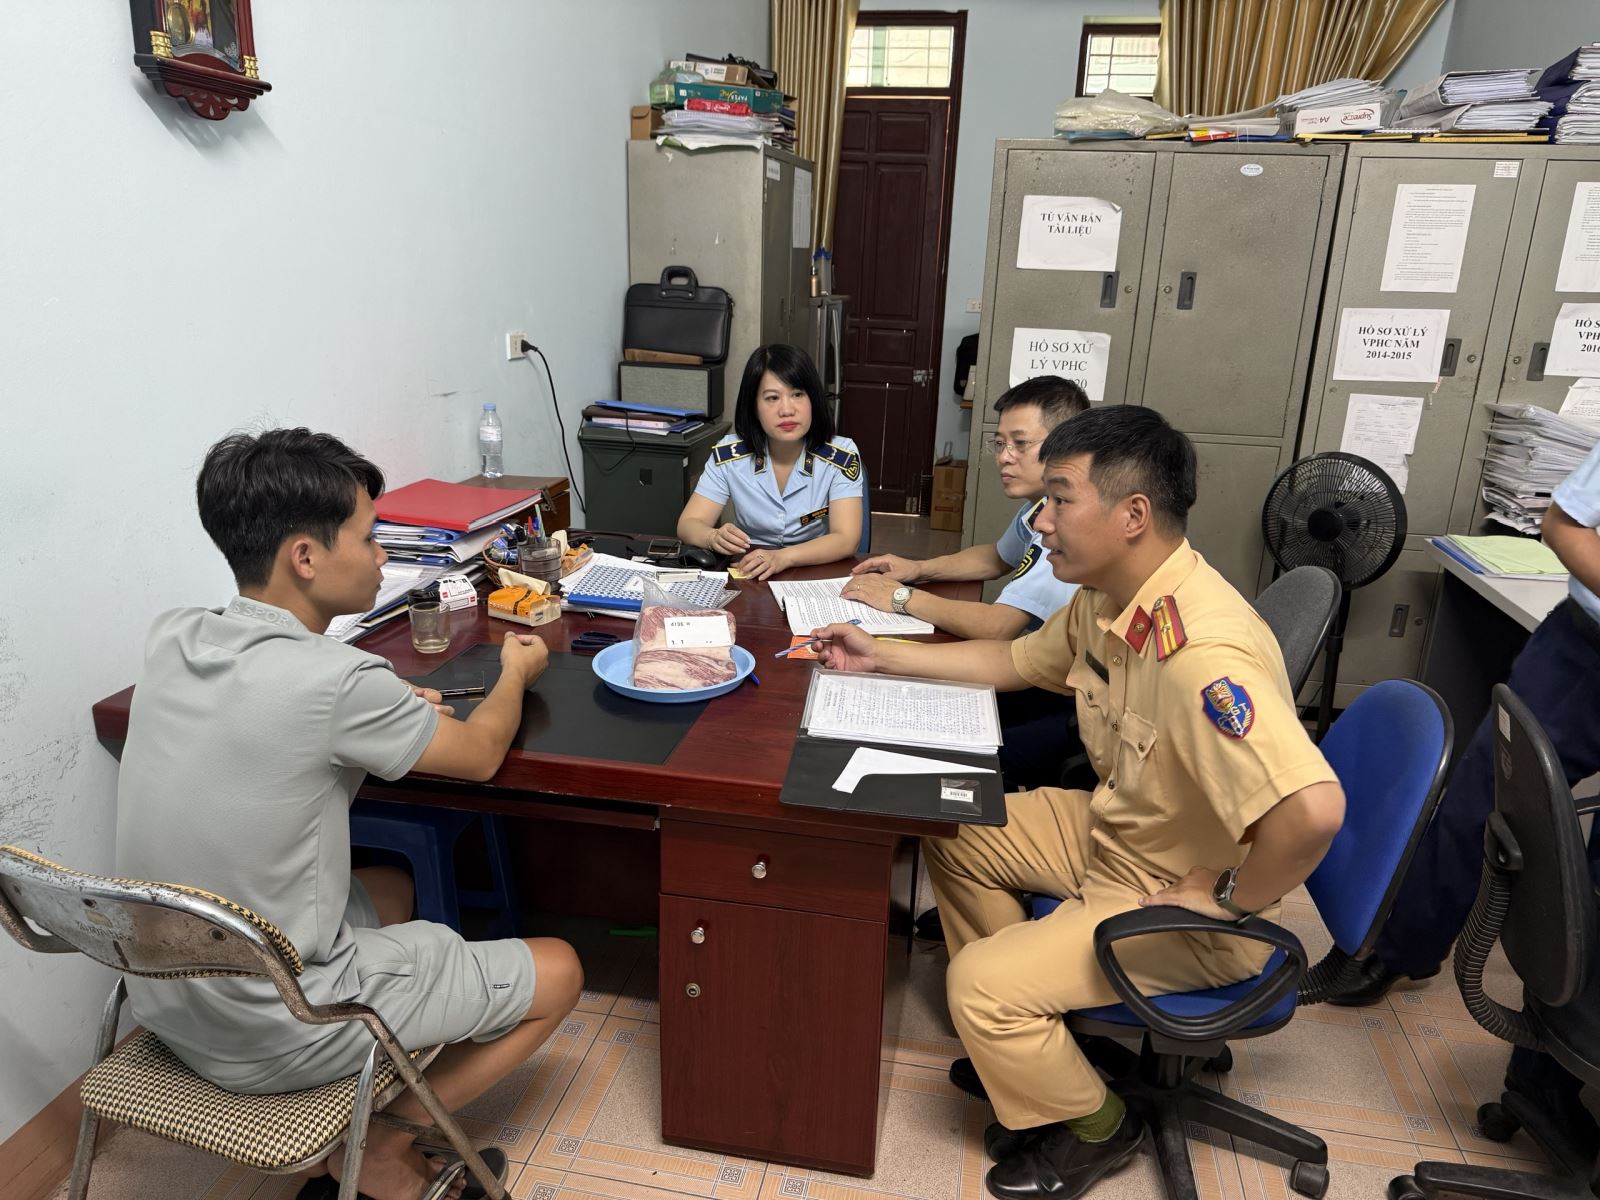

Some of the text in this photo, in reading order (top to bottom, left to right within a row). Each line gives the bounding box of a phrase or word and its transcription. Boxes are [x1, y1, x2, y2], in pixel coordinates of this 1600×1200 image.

[1057, 212, 1079, 223] VĂN
[1413, 326, 1428, 337] LÝ
[1579, 331, 1600, 340] VPH
[1051, 341, 1070, 353] SƠ
[1362, 338, 1420, 349] VPHC NĂM
[1366, 350, 1412, 360] 2014-2015
[1052, 359, 1088, 371] VPHC
